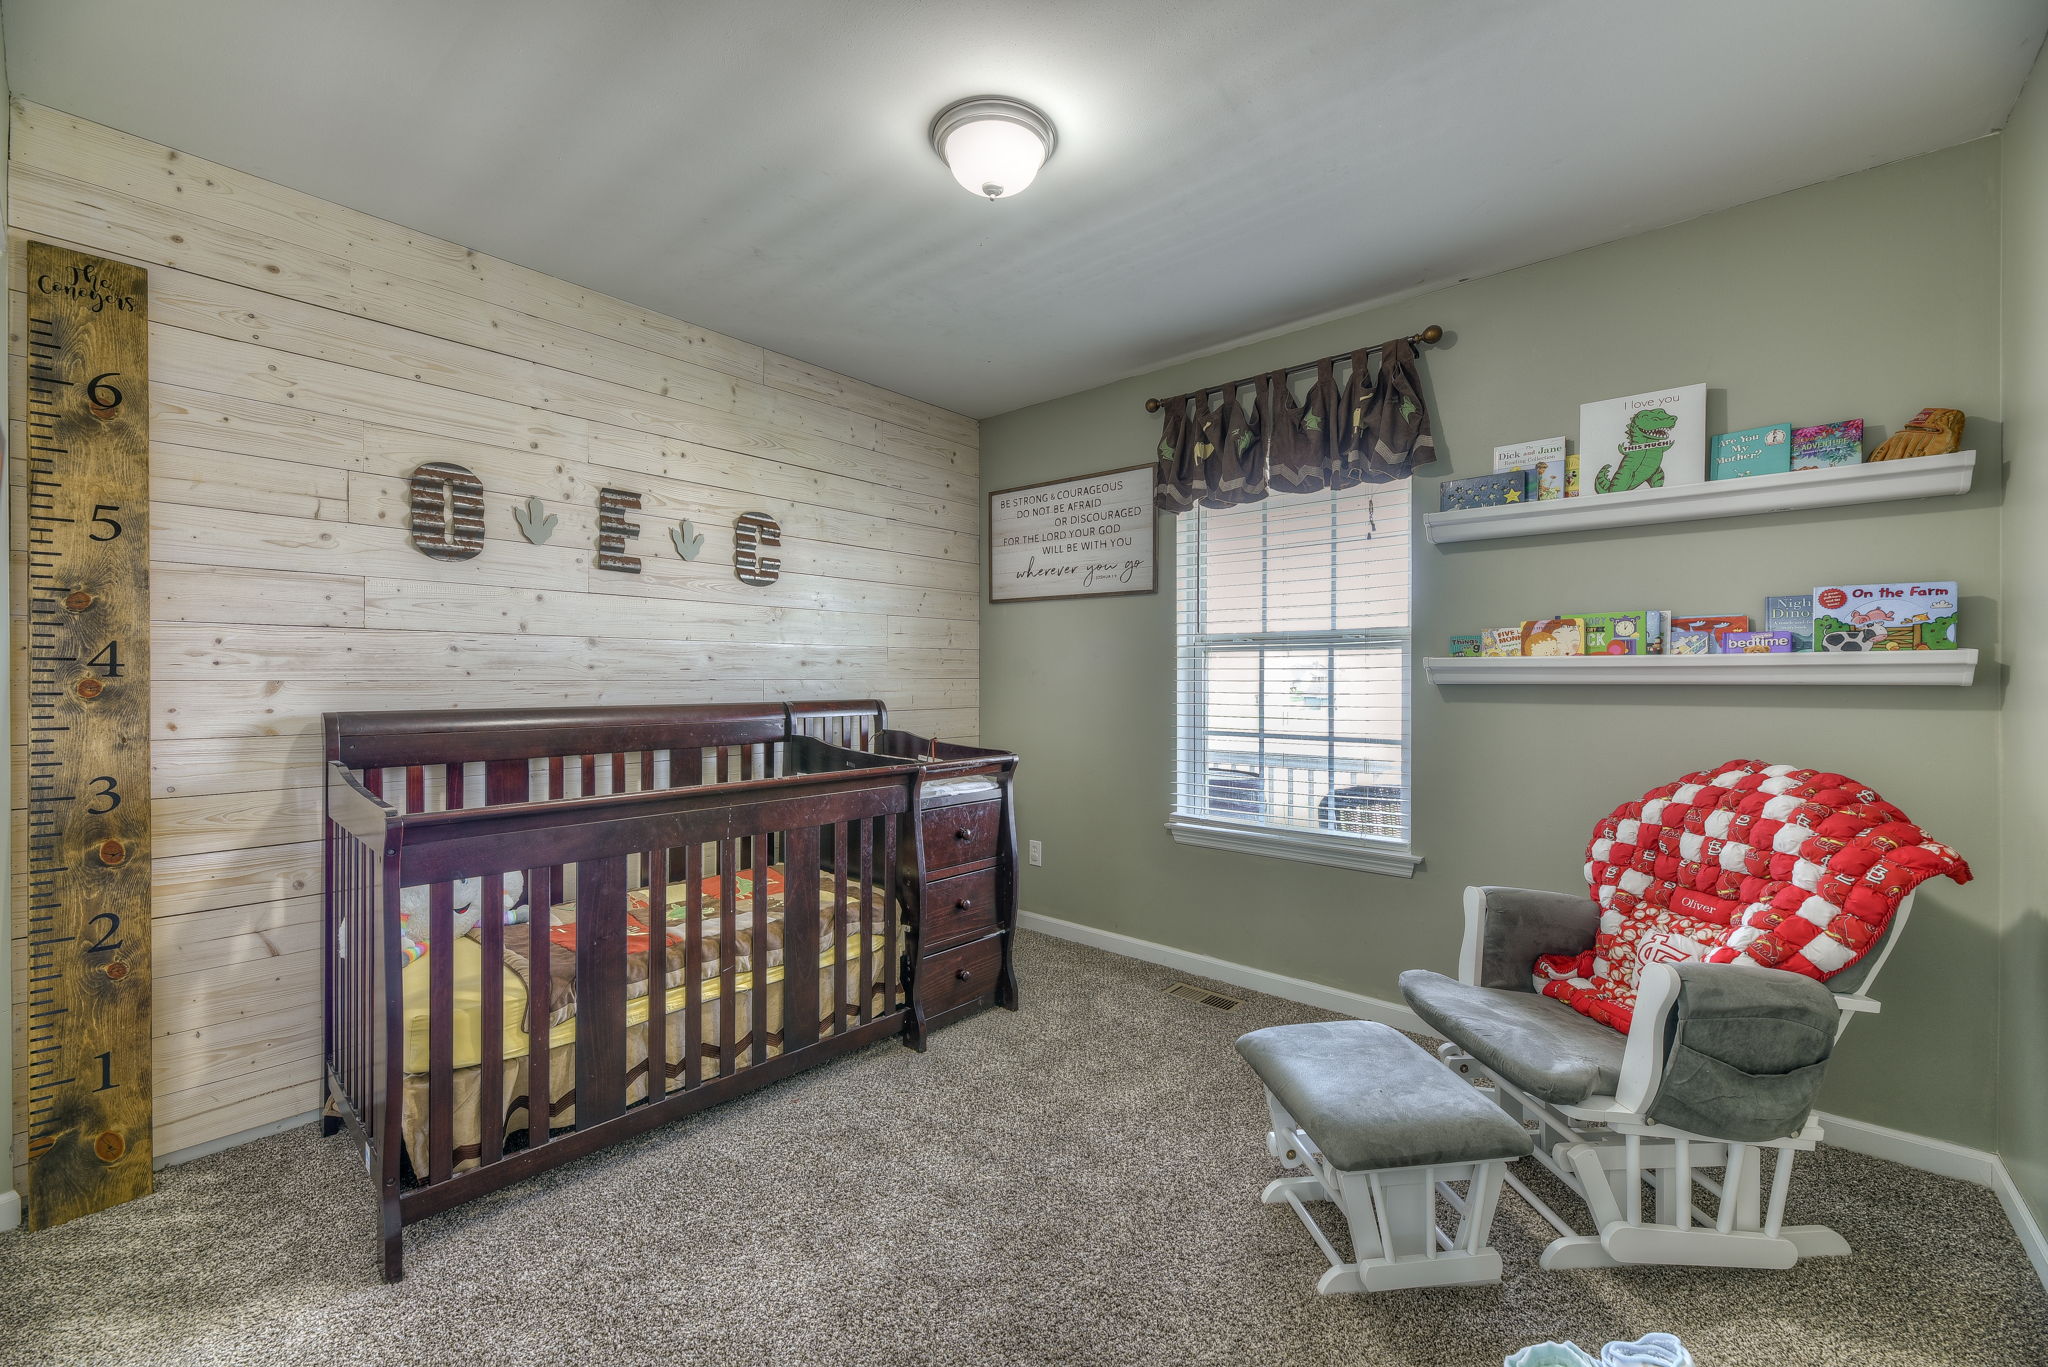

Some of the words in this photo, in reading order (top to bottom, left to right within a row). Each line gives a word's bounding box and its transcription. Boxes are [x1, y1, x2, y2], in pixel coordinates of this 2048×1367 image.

[65, 265, 112, 292] The
[87, 372, 123, 411] 6
[1631, 399, 1655, 409] love
[1658, 394, 1680, 407] you
[1623, 444, 1643, 452] THIS
[1718, 439, 1737, 448] Are
[1740, 434, 1760, 443] You
[1730, 444, 1750, 453] My
[1801, 437, 1850, 451] ADVENTURE
[1499, 451, 1521, 461] Dick
[1537, 446, 1562, 454] Jane
[1527, 455, 1556, 463] Collection
[1716, 449, 1763, 465] Mother?
[1000, 499, 1011, 509] BE
[1012, 493, 1049, 508] STRONG
[1056, 481, 1124, 500] COURAGEOUS
[1016, 510, 1030, 519] DO
[1032, 507, 1050, 517] NOT
[1053, 504, 1065, 514] BE
[1067, 498, 1102, 511] AFRAID
[1054, 517, 1068, 526] OR
[1070, 506, 1142, 525] DISCOURAGED
[88, 505, 123, 542] 5
[599, 487, 642, 574] E
[735, 511, 782, 587] C
[1003, 537, 1020, 546] FOR
[1023, 534, 1040, 544] THE
[1042, 531, 1067, 541] LORD
[1069, 527, 1096, 538] YOUR
[1098, 524, 1121, 535] GOD
[1042, 545, 1064, 555] WILL
[1066, 542, 1078, 552] BE
[1081, 540, 1107, 551] WITH
[1111, 537, 1132, 548] YOU
[1016, 556, 1079, 579] wherever
[1083, 563, 1118, 587] you
[1119, 558, 1145, 583] go
[1852, 588, 1874, 598] On
[1878, 587, 1904, 598] the
[1909, 586, 1949, 597] Farm
[1497, 630, 1515, 638] FIVE
[1587, 633, 1605, 646] CK
[1728, 636, 1789, 649] bedtime
[87, 640, 126, 678] 4
[88, 775, 121, 815] 3
[1680, 897, 1717, 915] Oliver
[87, 912, 124, 953] 2
[91, 1050, 120, 1093] 1
